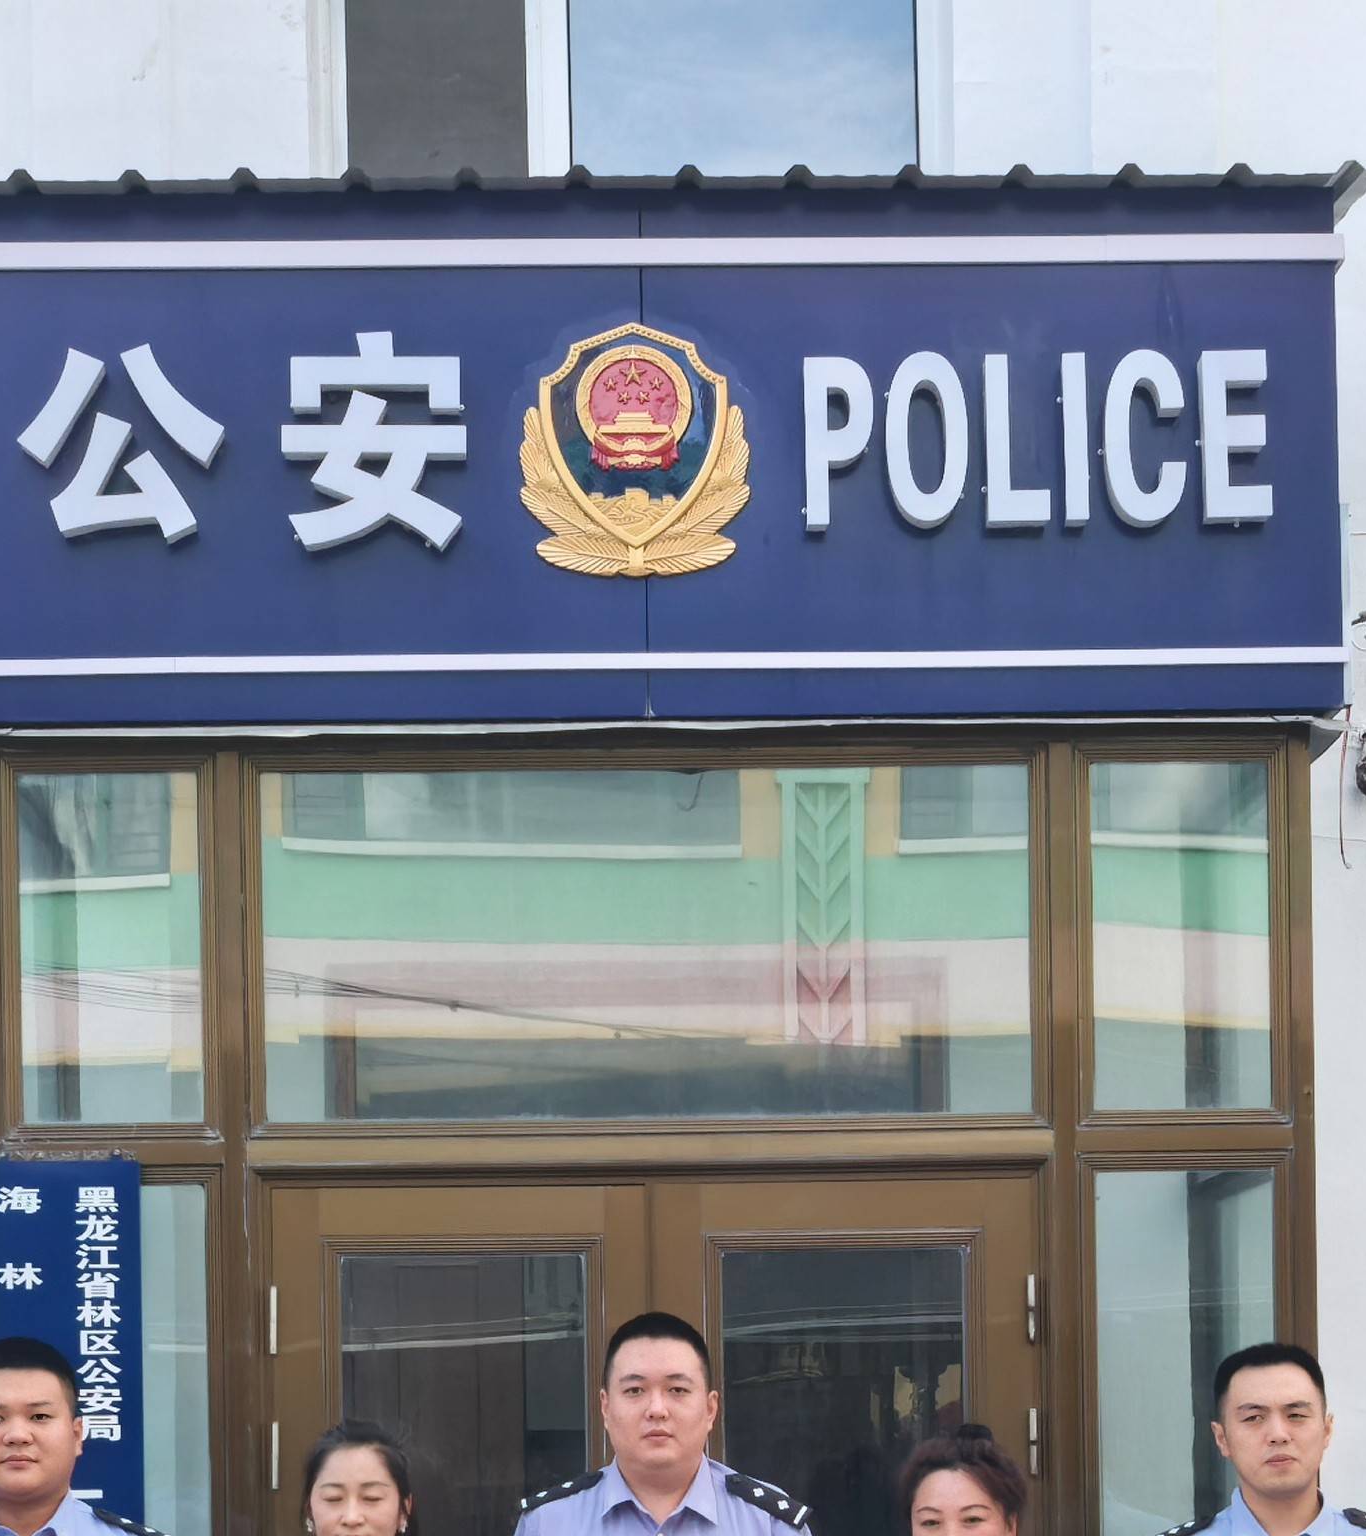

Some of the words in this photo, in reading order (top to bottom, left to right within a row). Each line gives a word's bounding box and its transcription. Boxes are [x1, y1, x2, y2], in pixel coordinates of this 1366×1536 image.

[17, 331, 466, 546] 公安
[802, 349, 1273, 526] POLICE
[75, 1186, 122, 1441] 黑龙江省林区公安局
